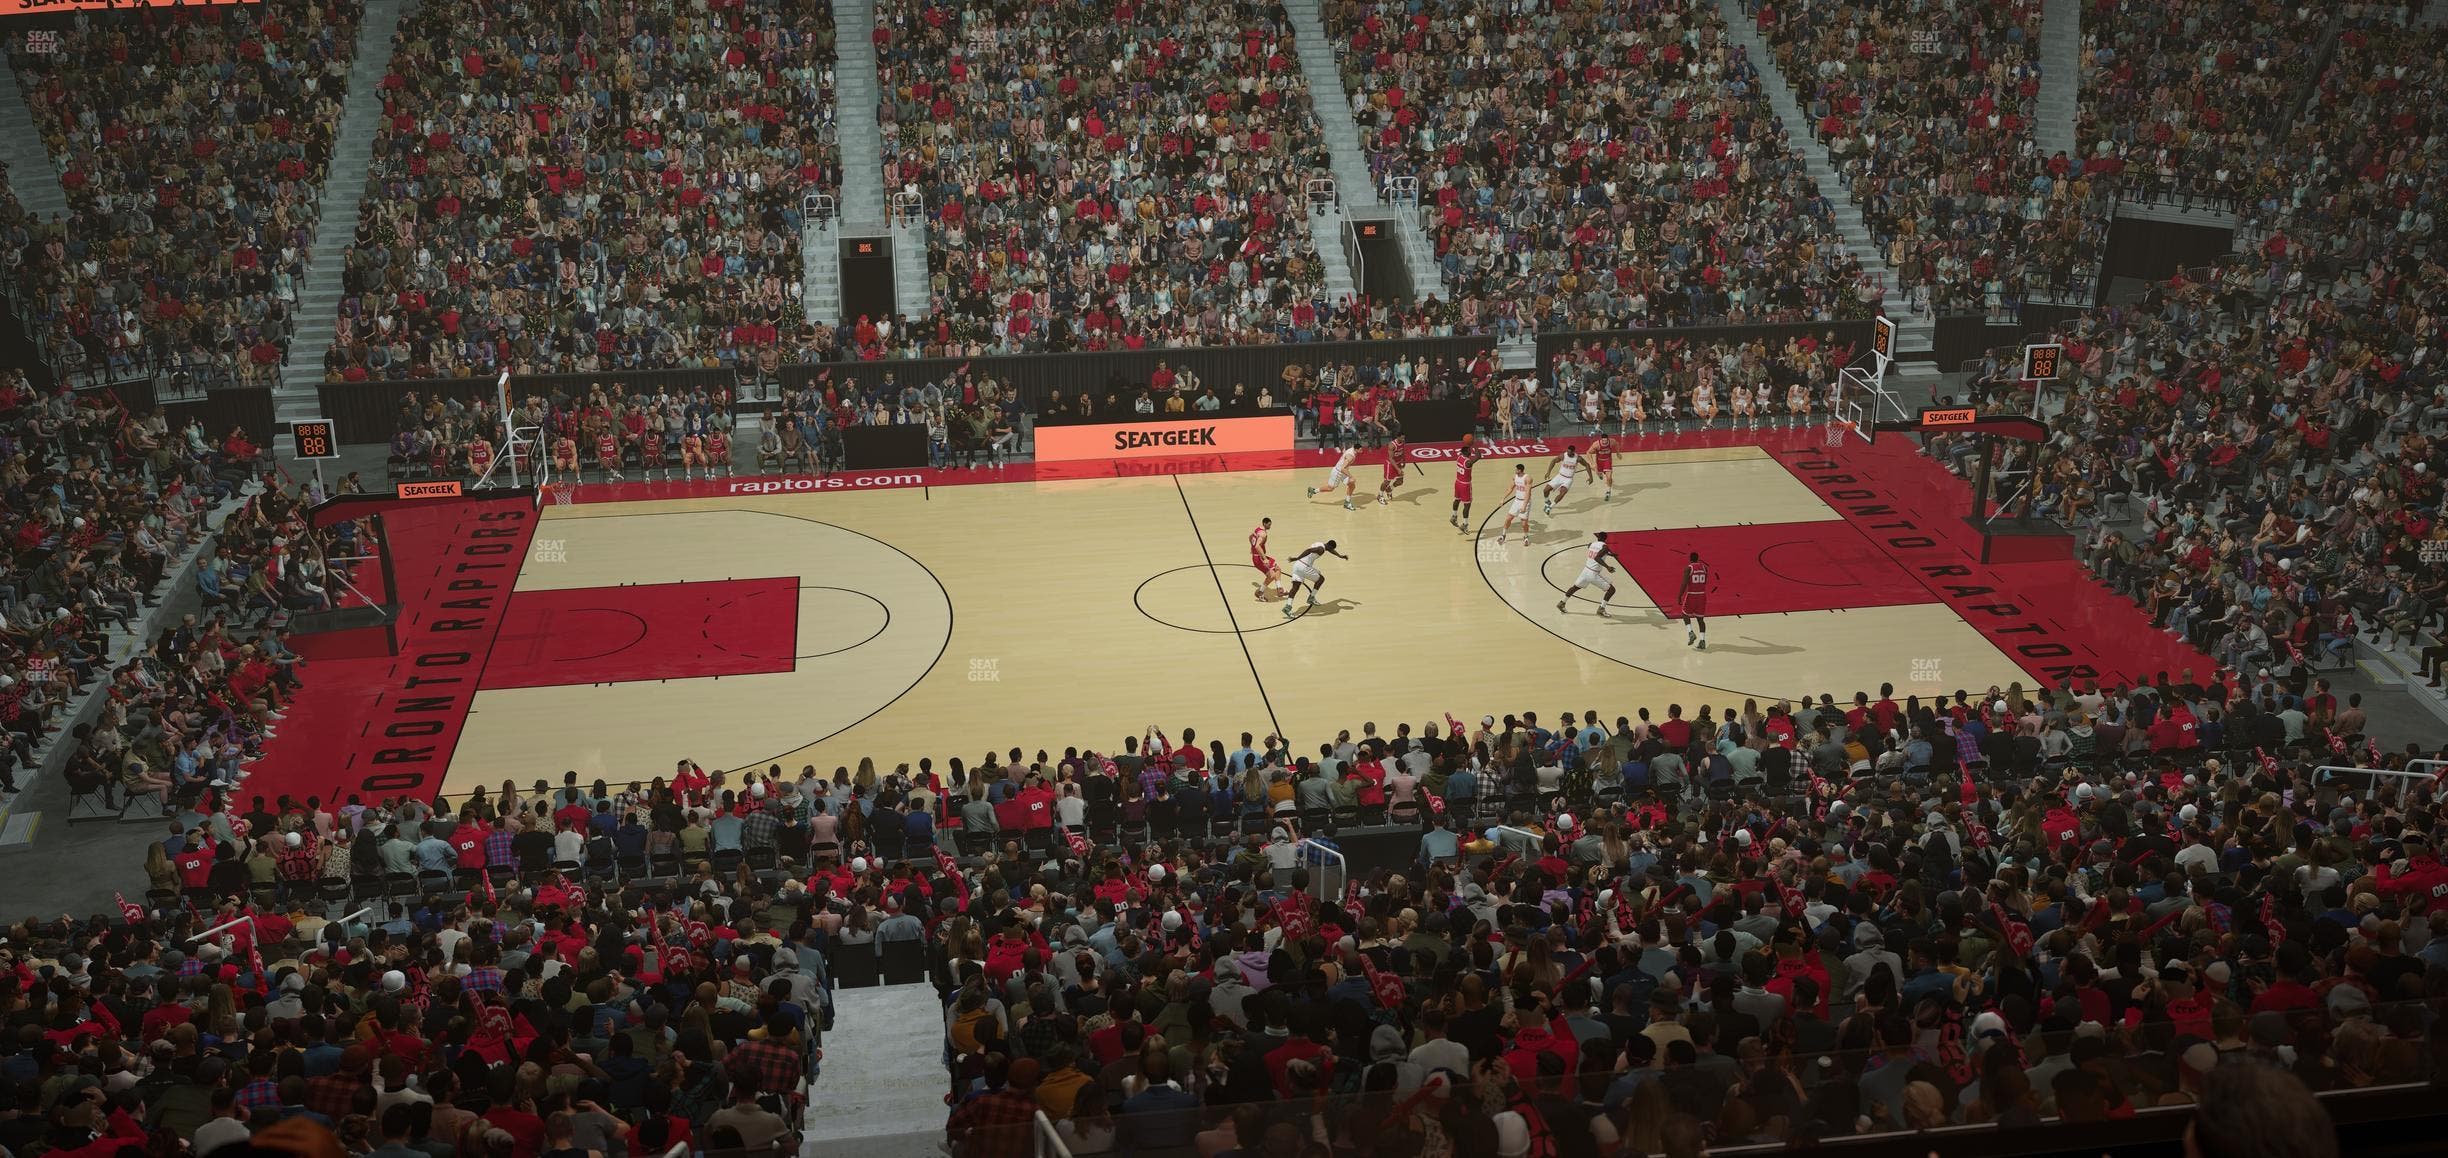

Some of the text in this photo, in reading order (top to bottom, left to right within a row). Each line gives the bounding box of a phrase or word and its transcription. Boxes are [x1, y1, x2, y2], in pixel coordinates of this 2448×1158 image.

[2034, 360, 2052, 377] 88
[1929, 411, 1970, 423] SEATGEEK
[303, 437, 326, 455] 88
[1115, 426, 1217, 450] SEATGEEK
[1411, 444, 1550, 459] @rptors
[404, 484, 455, 496] SEATGEEK
[730, 474, 923, 493] raptors.com
[1780, 447, 2115, 696] TORONTO RAPTOR
[362, 511, 525, 793] ORONTO RAPTORS
[1031, 802, 1044, 811] 00
[461, 840, 475, 850] 00
[186, 860, 200, 869] 00
